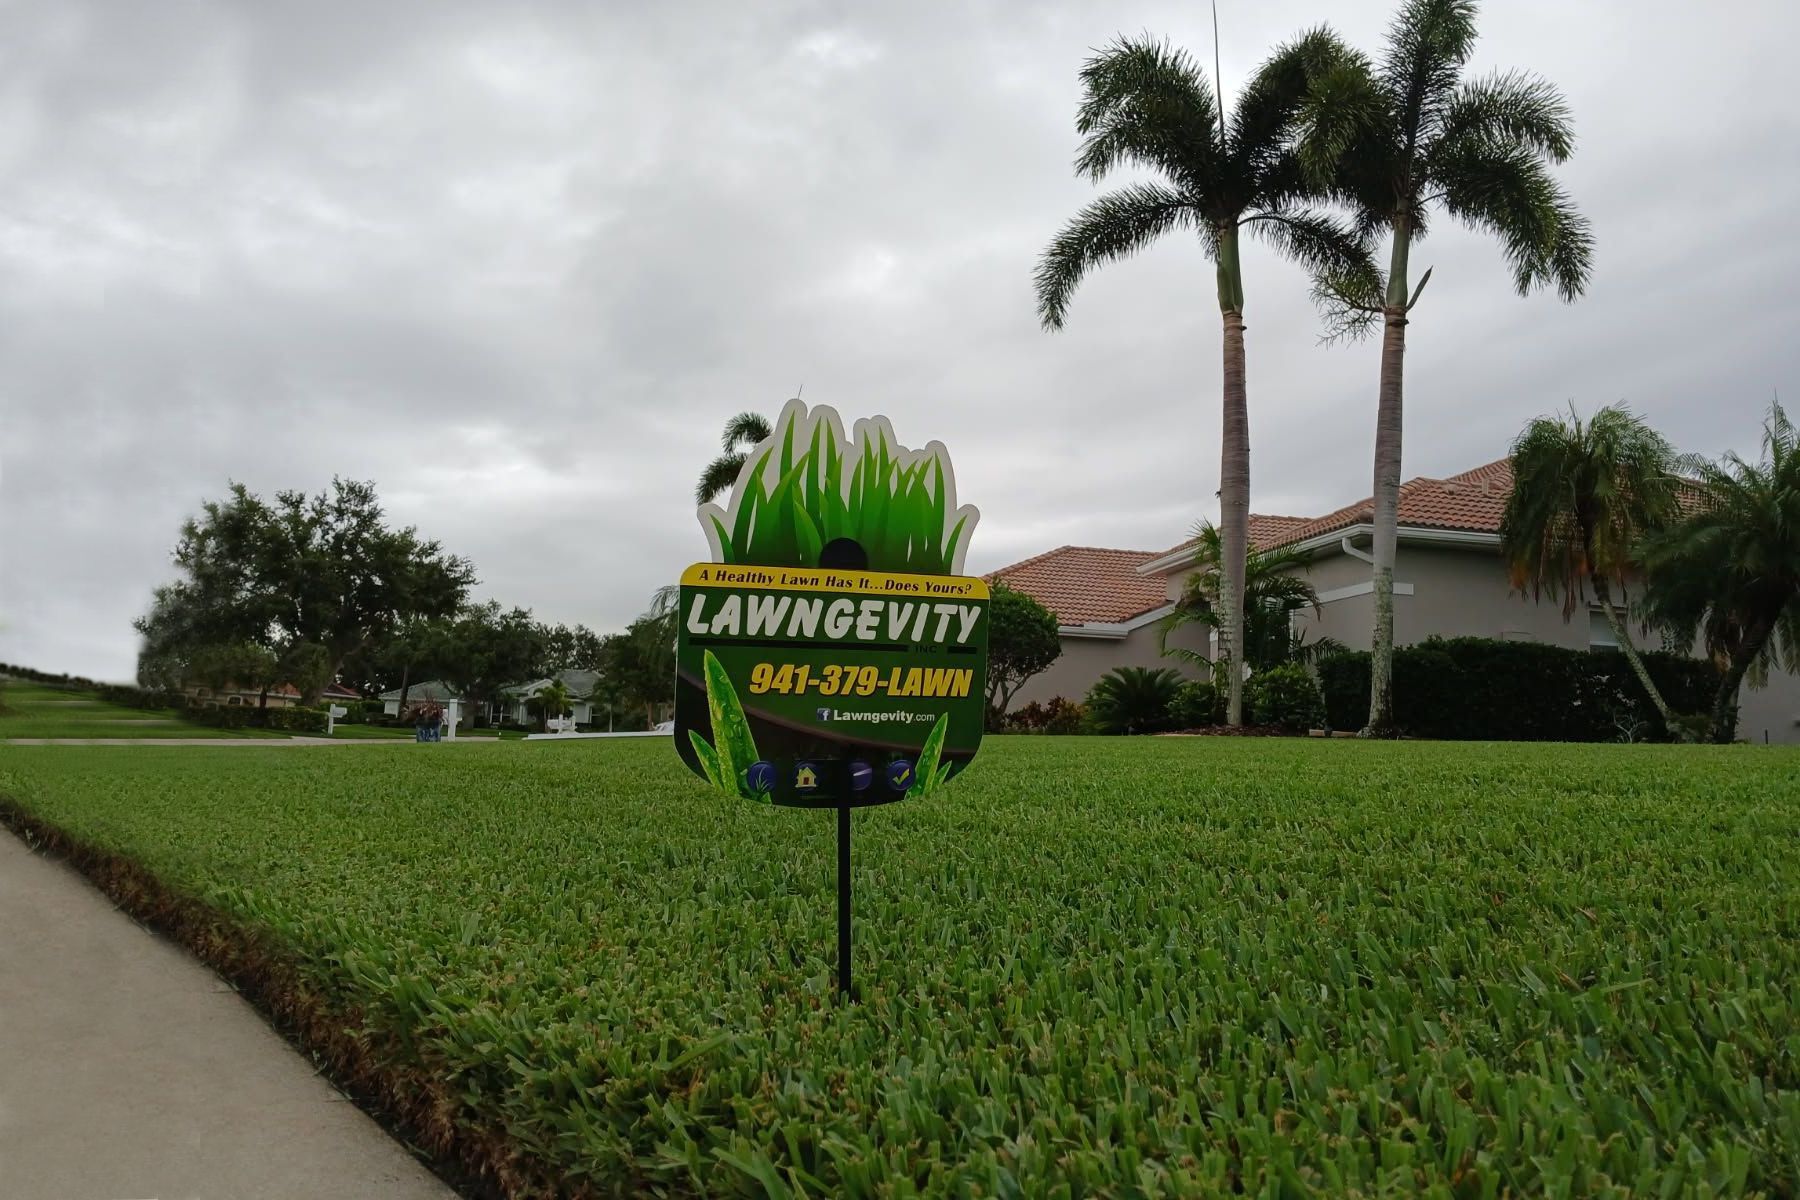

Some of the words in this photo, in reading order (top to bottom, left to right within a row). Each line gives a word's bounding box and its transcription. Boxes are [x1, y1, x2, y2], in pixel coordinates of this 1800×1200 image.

[699, 570, 709, 581] A
[715, 570, 774, 586] Healthy
[781, 573, 819, 586] Lawn
[825, 575, 853, 588] Has
[925, 581, 972, 595] Yours?
[687, 593, 981, 644] LAWNGEVITY
[749, 663, 973, 697] 941-379-LAWN
[833, 709, 935, 724] Lawngevity.com
